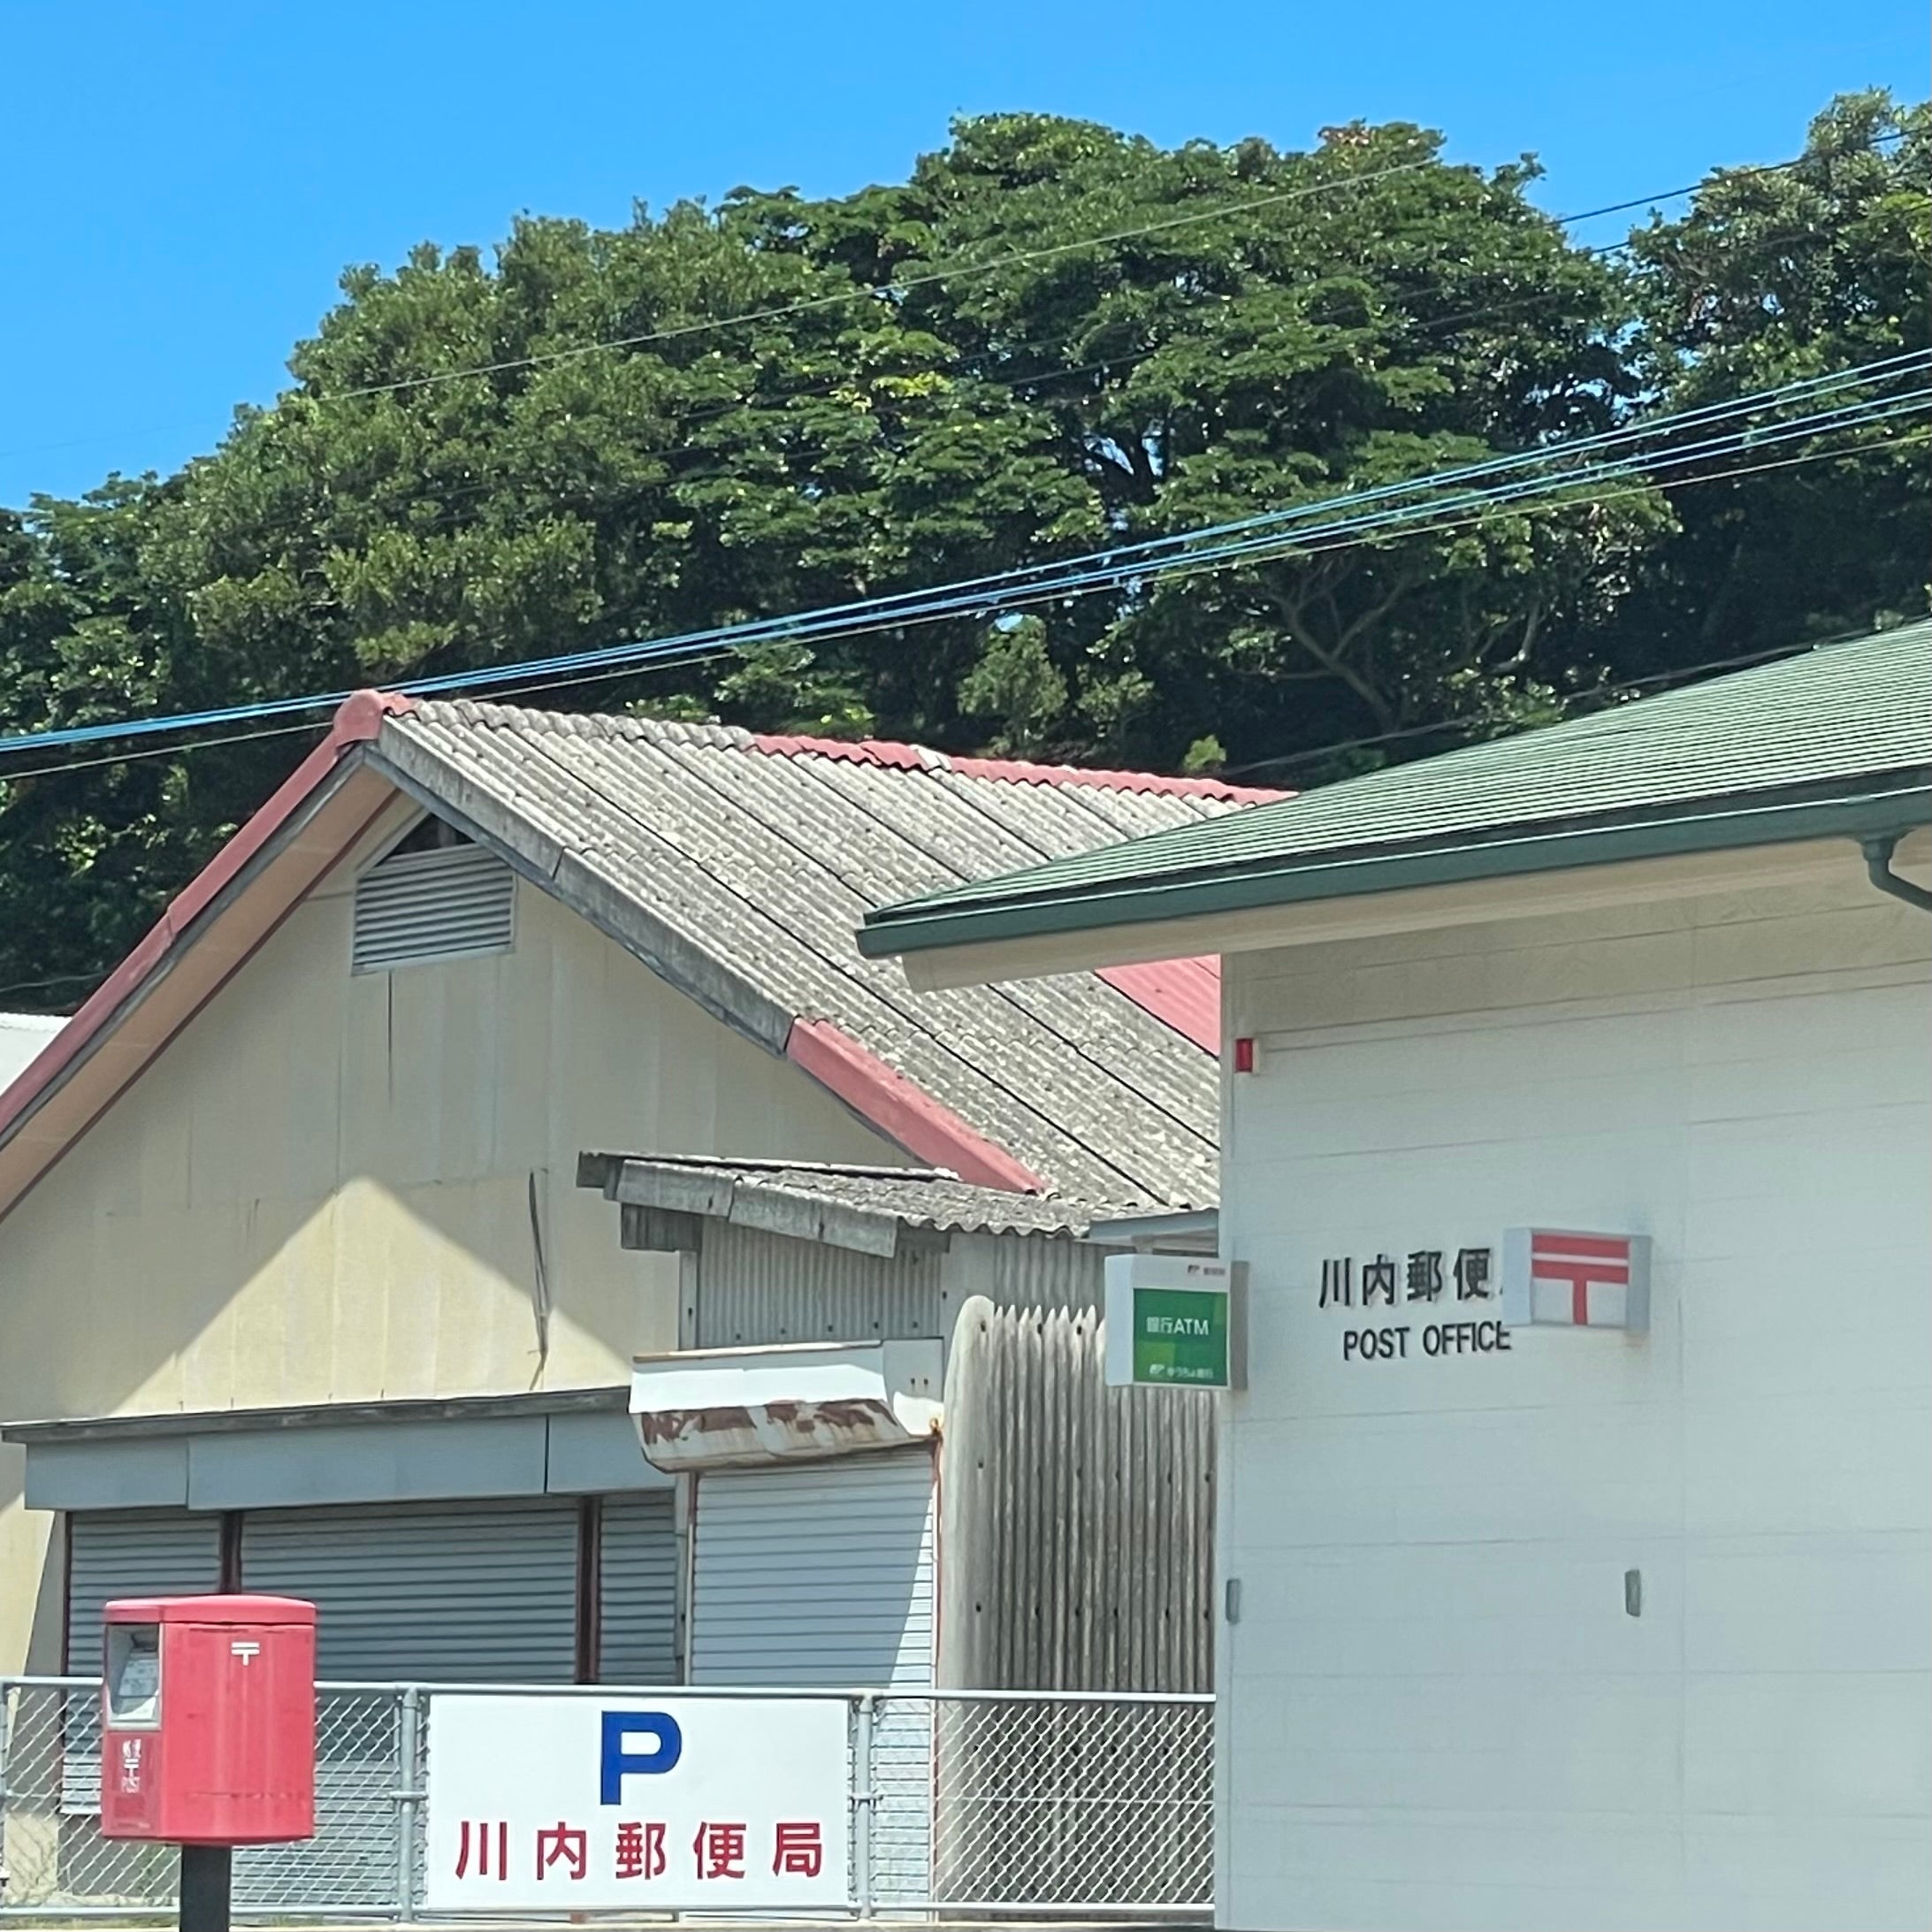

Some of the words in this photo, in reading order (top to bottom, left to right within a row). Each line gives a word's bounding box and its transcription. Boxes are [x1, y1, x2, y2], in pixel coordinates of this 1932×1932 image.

[1317, 1248, 1503, 1309] 川内郵便
[1343, 1326, 1410, 1361] POST
[1422, 1320, 1513, 1356] OFFICE
[599, 1710, 683, 1806] P
[454, 1820, 822, 1881] 川内郵便局
